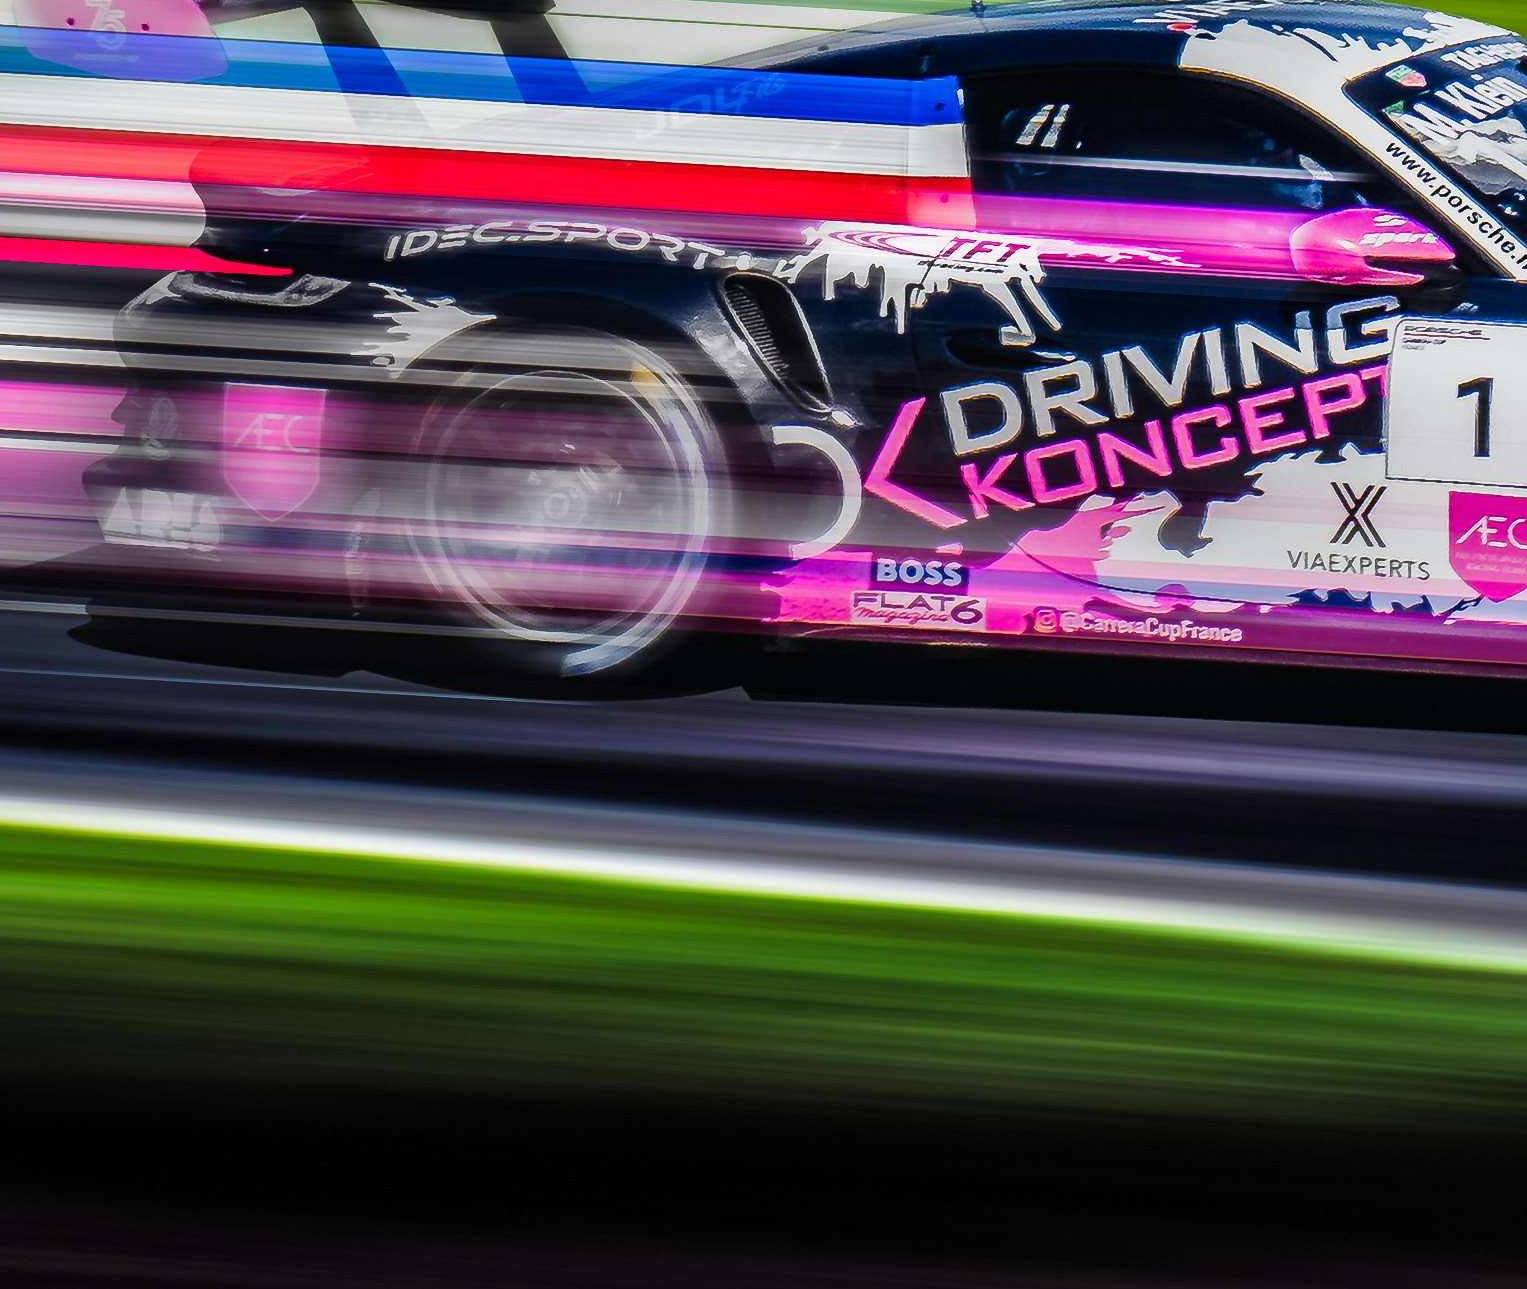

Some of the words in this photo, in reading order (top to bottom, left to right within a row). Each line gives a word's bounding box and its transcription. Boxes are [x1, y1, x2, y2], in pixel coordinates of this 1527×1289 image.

[940, 236, 1032, 263] TFT
[939, 294, 1404, 456] DRIVING
[1457, 376, 1495, 458] 1
[875, 558, 963, 587] BOSS
[1286, 550, 1431, 581] VIAEXPERTS
[853, 592, 955, 612] FLAT
[950, 599, 983, 625] 6
